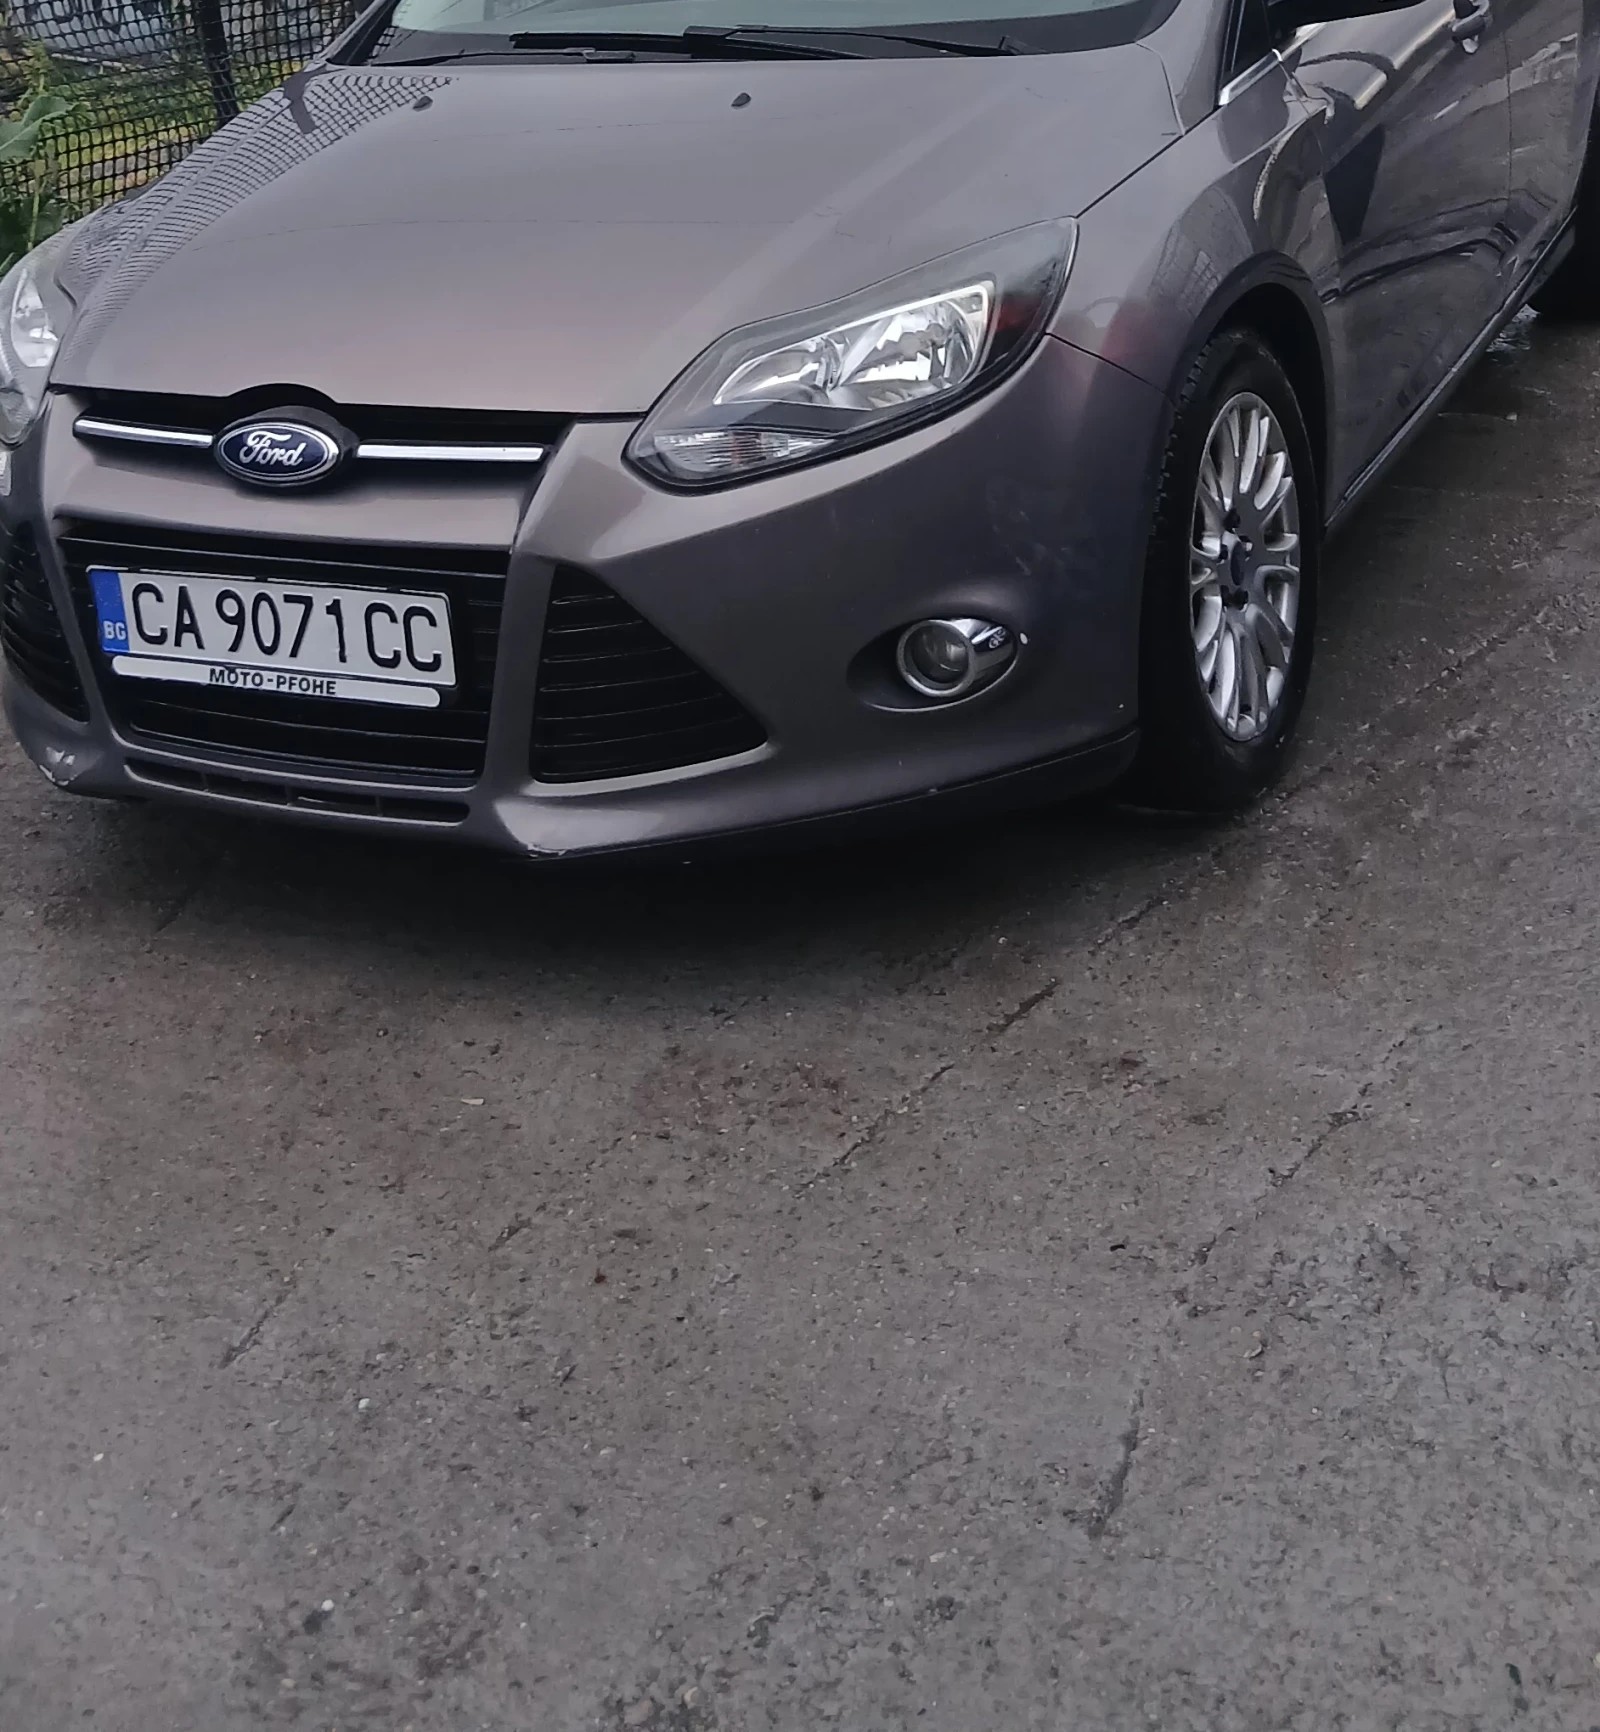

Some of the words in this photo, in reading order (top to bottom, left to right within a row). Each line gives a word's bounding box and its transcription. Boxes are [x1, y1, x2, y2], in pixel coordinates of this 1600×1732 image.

[240, 431, 307, 466] Ford
[103, 620, 127, 642] BG
[131, 581, 205, 651] CA
[215, 588, 348, 664] 9071
[364, 601, 442, 672] CC
[208, 667, 337, 696] MOTO-PFOHE
